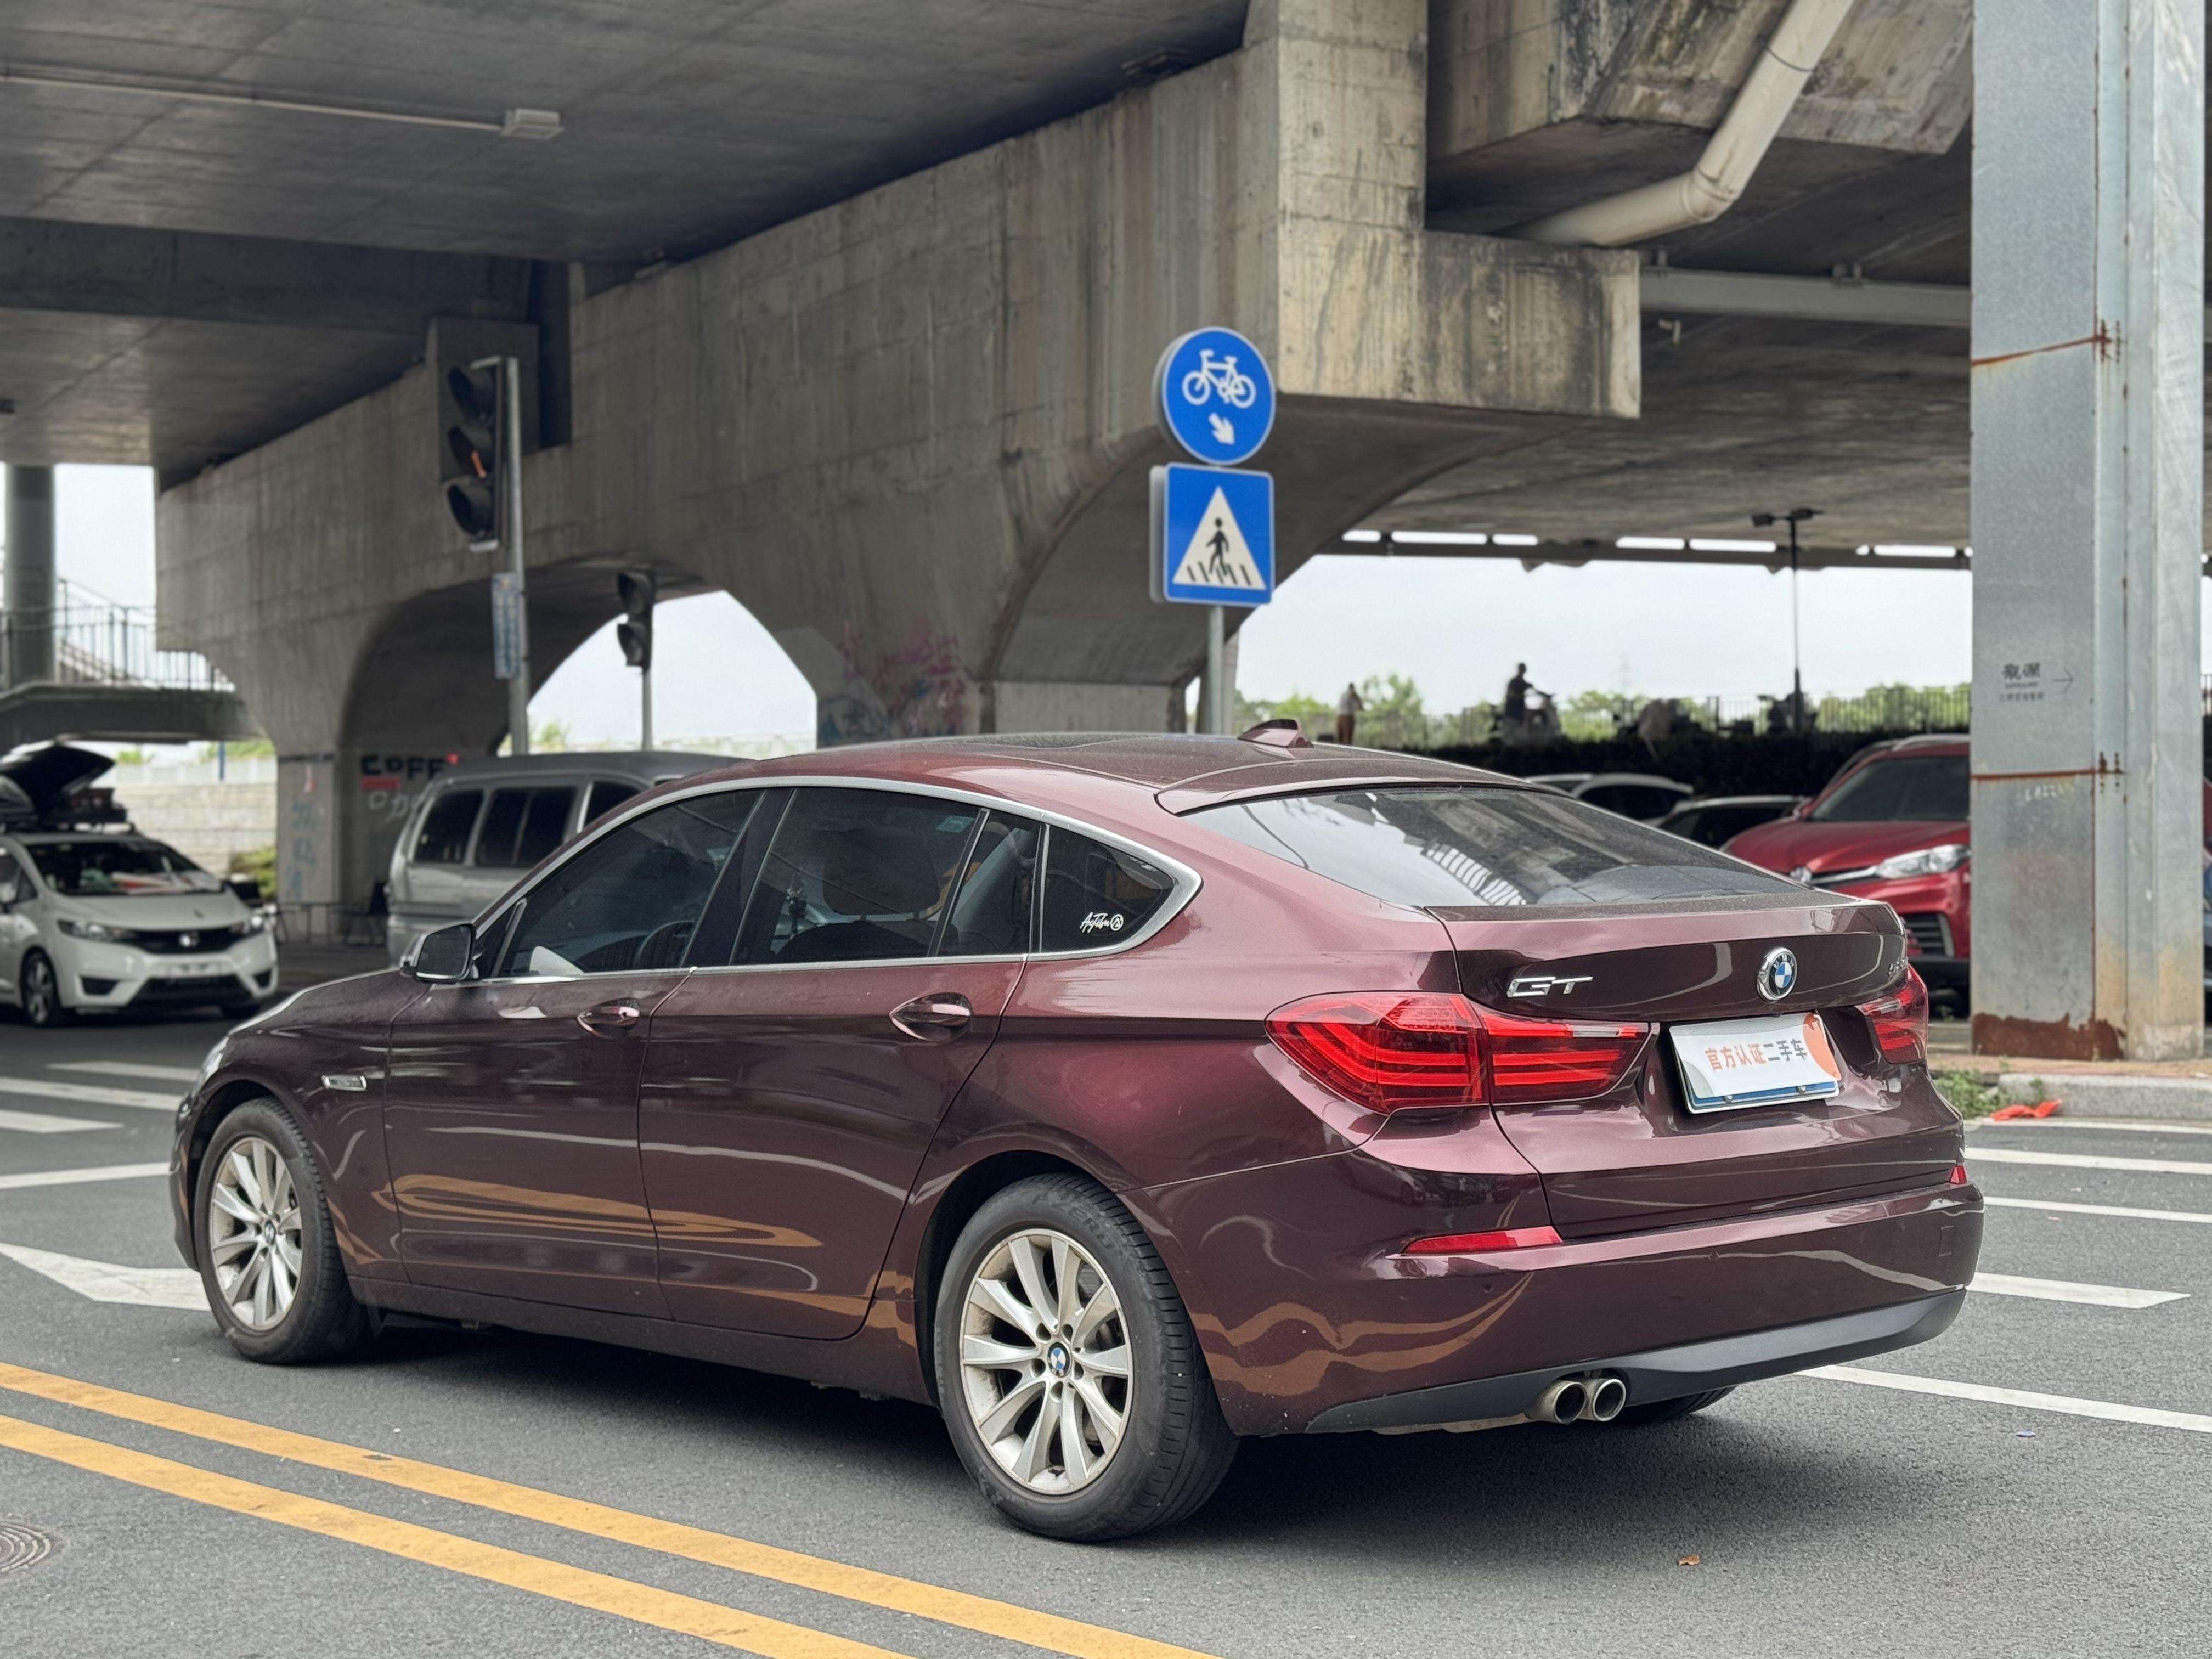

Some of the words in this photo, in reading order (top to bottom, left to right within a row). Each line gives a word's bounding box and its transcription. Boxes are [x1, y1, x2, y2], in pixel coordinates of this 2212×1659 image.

[1507, 976, 1594, 998] GT
[1705, 1039, 1807, 1070] 官方认证二手车
